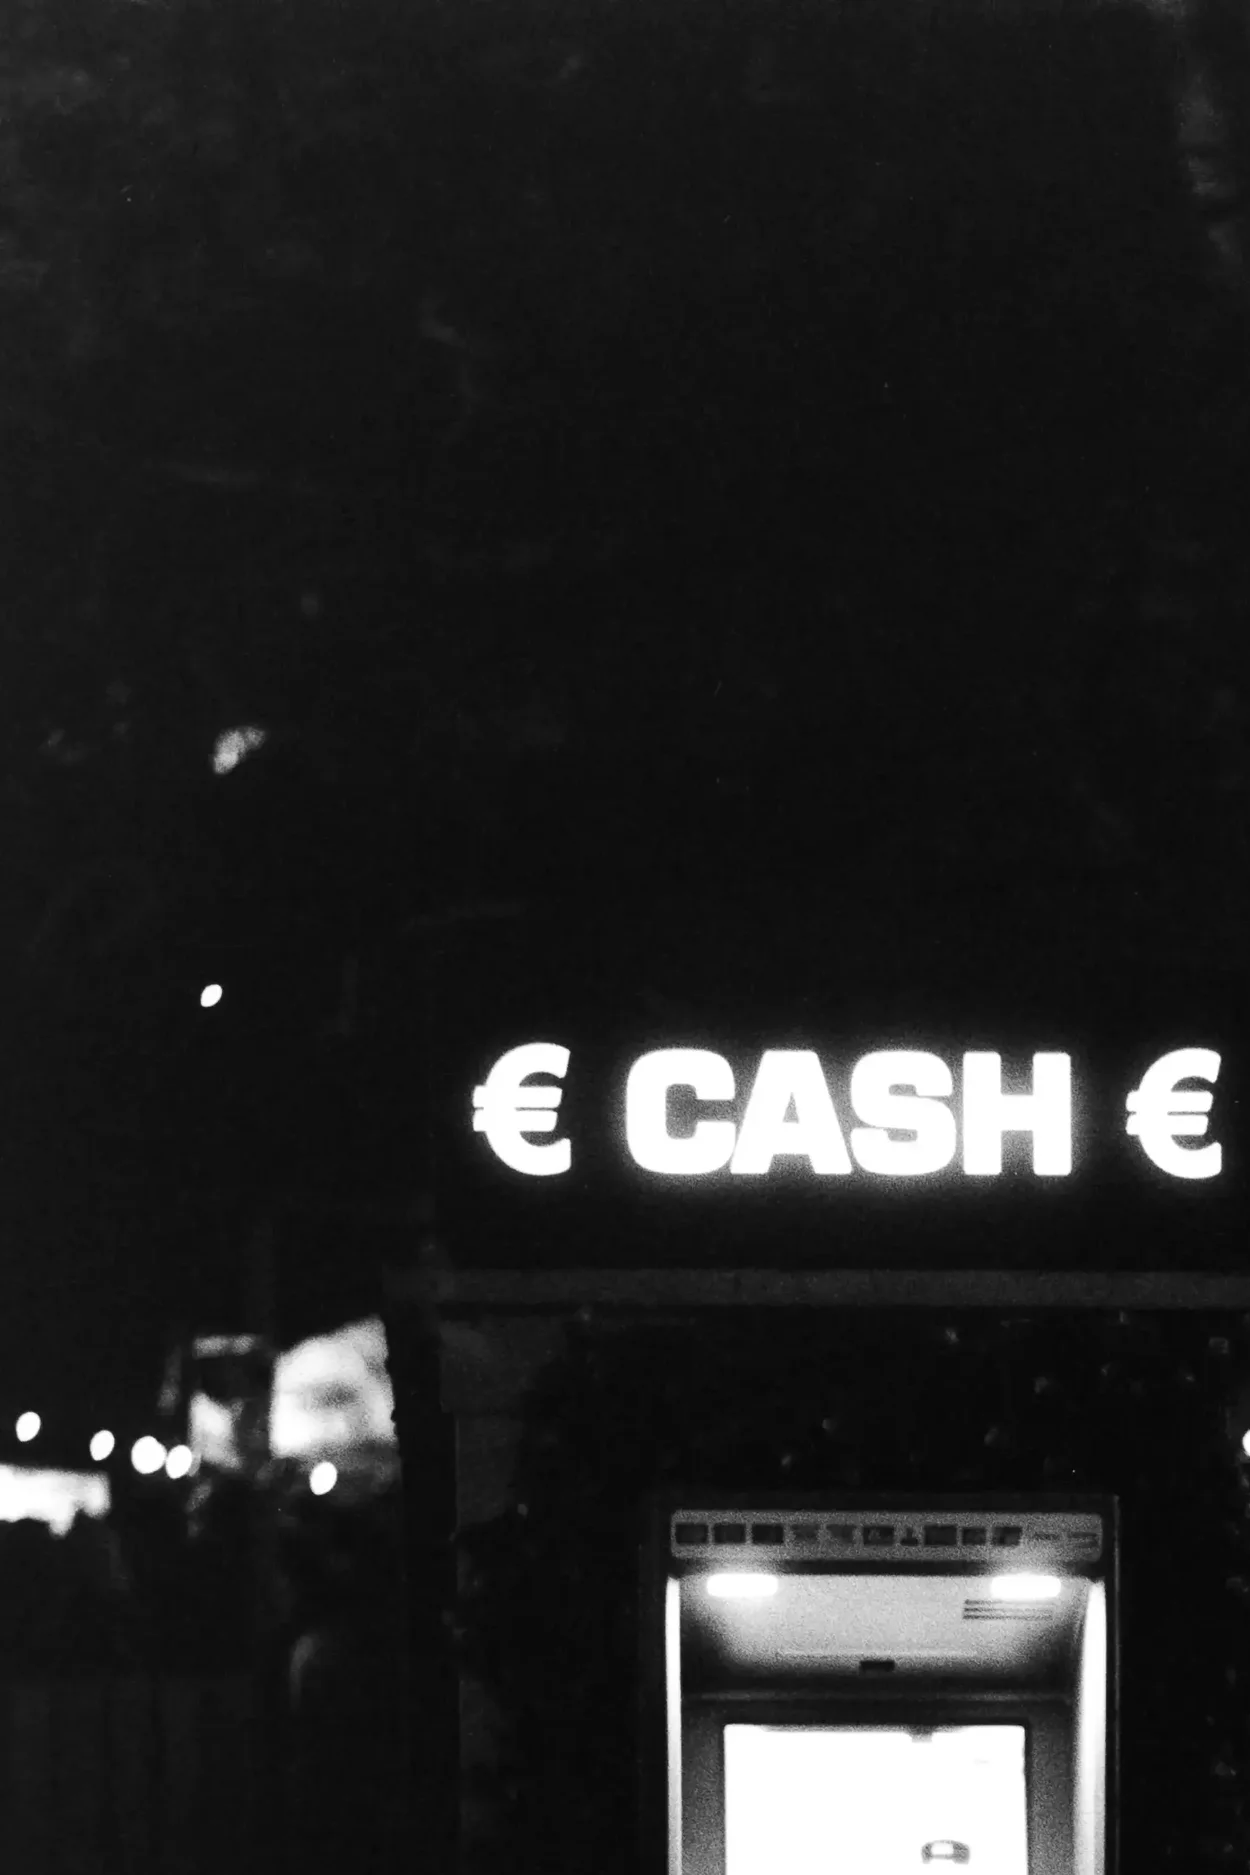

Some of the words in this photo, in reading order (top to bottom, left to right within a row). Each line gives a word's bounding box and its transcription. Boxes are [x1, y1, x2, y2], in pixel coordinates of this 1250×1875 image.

[472, 1043, 571, 1176] €
[626, 1048, 1072, 1176] CASH
[1125, 1048, 1222, 1179] €
